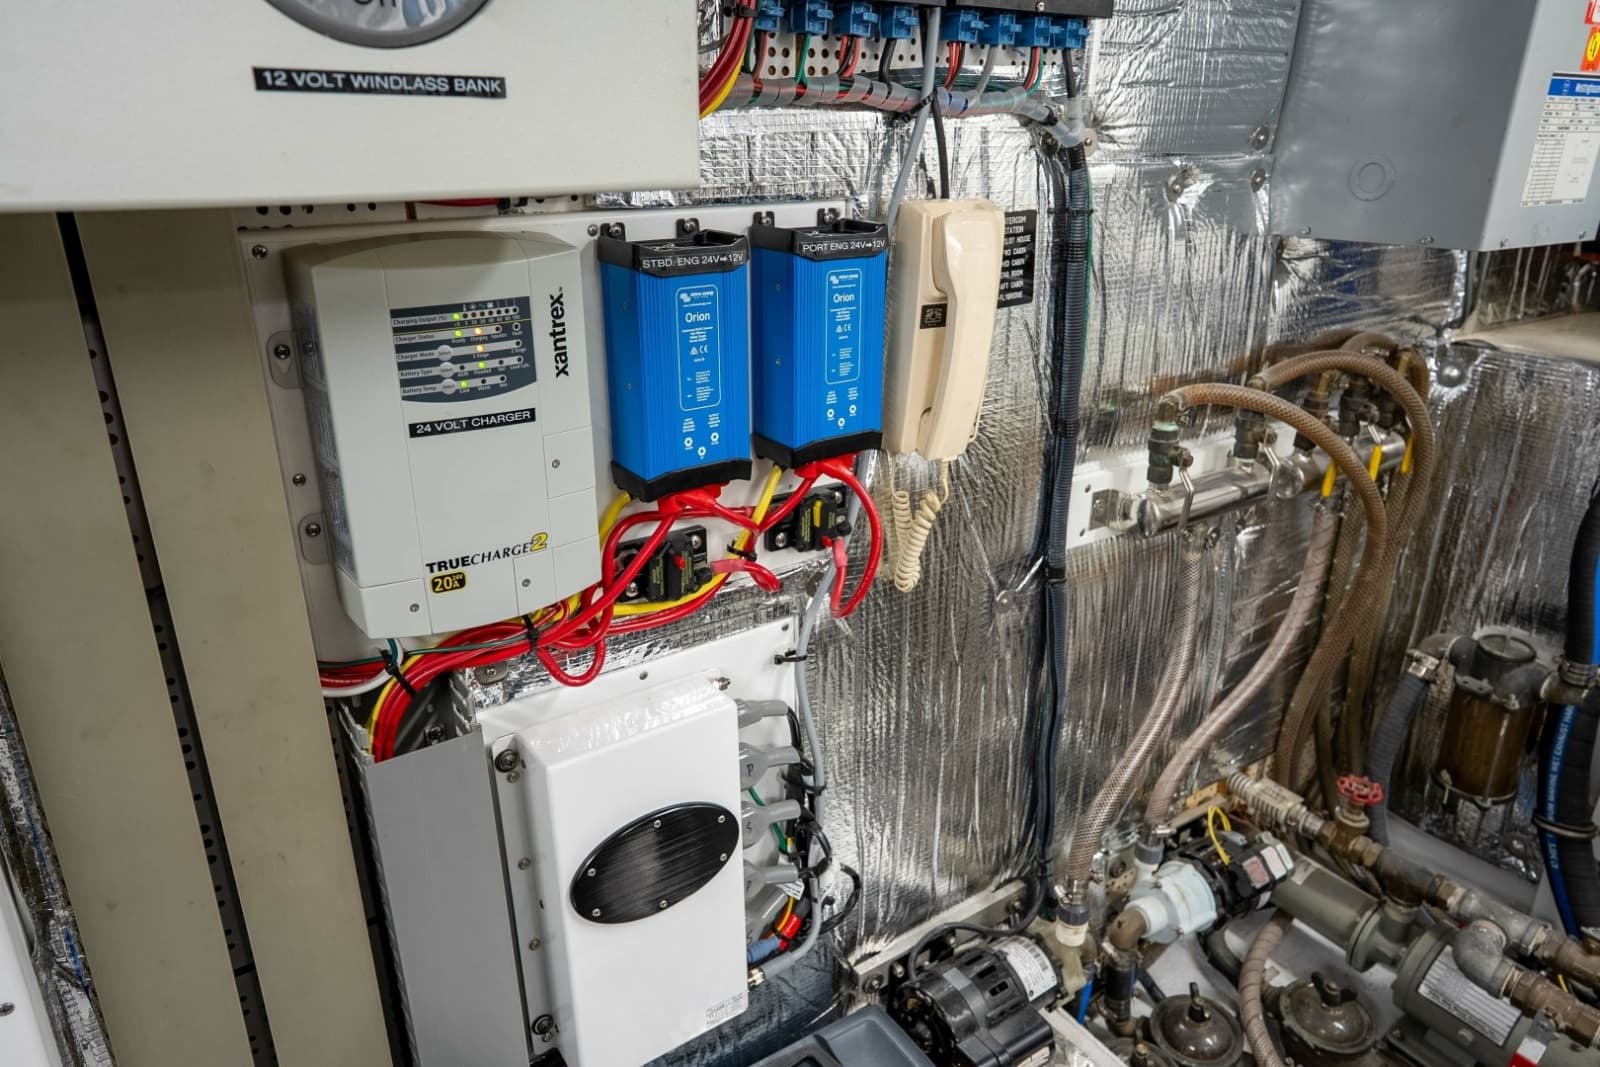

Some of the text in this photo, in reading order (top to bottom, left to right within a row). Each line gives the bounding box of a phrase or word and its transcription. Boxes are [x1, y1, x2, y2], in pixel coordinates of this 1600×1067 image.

[262, 70, 502, 93] 12 VOLT WINDLASS BANK
[803, 243, 828, 253] PORT
[830, 241, 849, 252] ENG
[677, 255, 700, 267] ENG
[833, 293, 855, 303] Orion
[393, 317, 418, 327] Charging
[418, 315, 437, 325] Output
[685, 312, 711, 323] Orion
[395, 334, 418, 343] Charger
[549, 293, 569, 378] xantrex
[397, 352, 419, 361] Charger
[400, 370, 420, 378] Battery
[402, 386, 423, 394] Battery
[416, 410, 531, 434] 24 VOLT CHARGER
